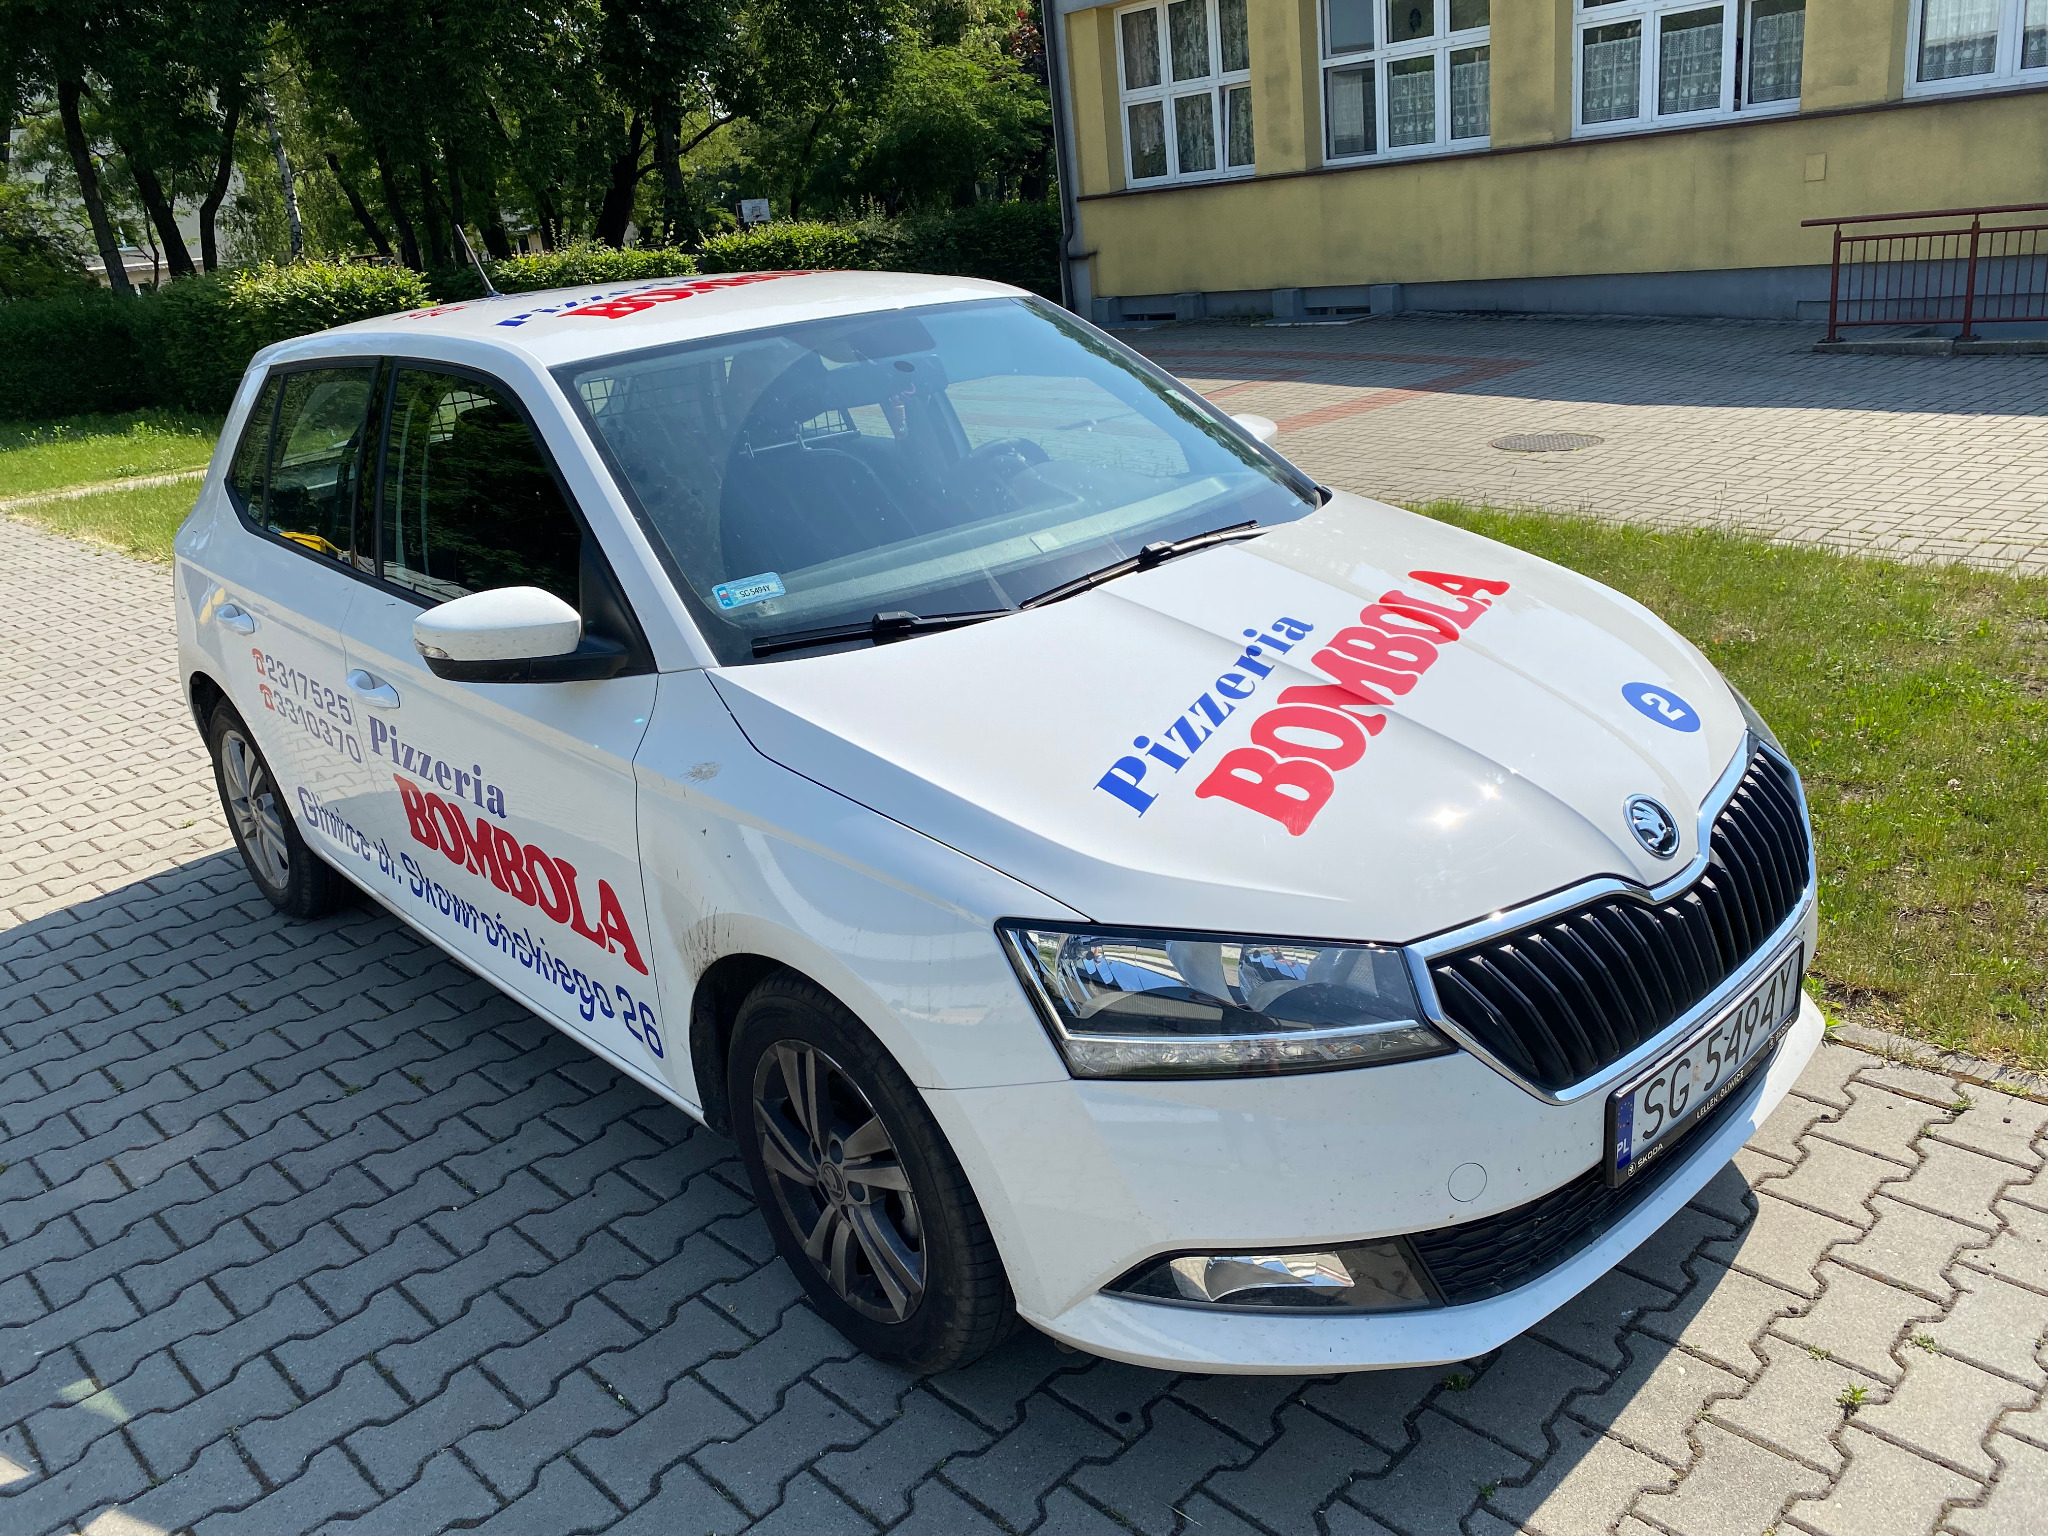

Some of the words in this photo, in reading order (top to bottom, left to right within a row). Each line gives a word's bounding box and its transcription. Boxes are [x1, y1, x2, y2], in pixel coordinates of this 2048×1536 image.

[265, 654, 352, 726] 2317525
[273, 690, 362, 764] 3310370
[1093, 610, 1315, 819] Pizzeria
[1194, 570, 1511, 837] BOMBOLA
[1640, 692, 1686, 722] 2
[367, 714, 508, 819] Pizzeria
[297, 786, 371, 861] Gliwice
[373, 838, 402, 884] ul.
[616, 985, 665, 1059] 26
[392, 773, 649, 976] BOMBOLA
[1642, 1058, 1692, 1140] SG
[1703, 958, 1794, 1092] 5494Y
[1616, 1137, 1630, 1160] PL
